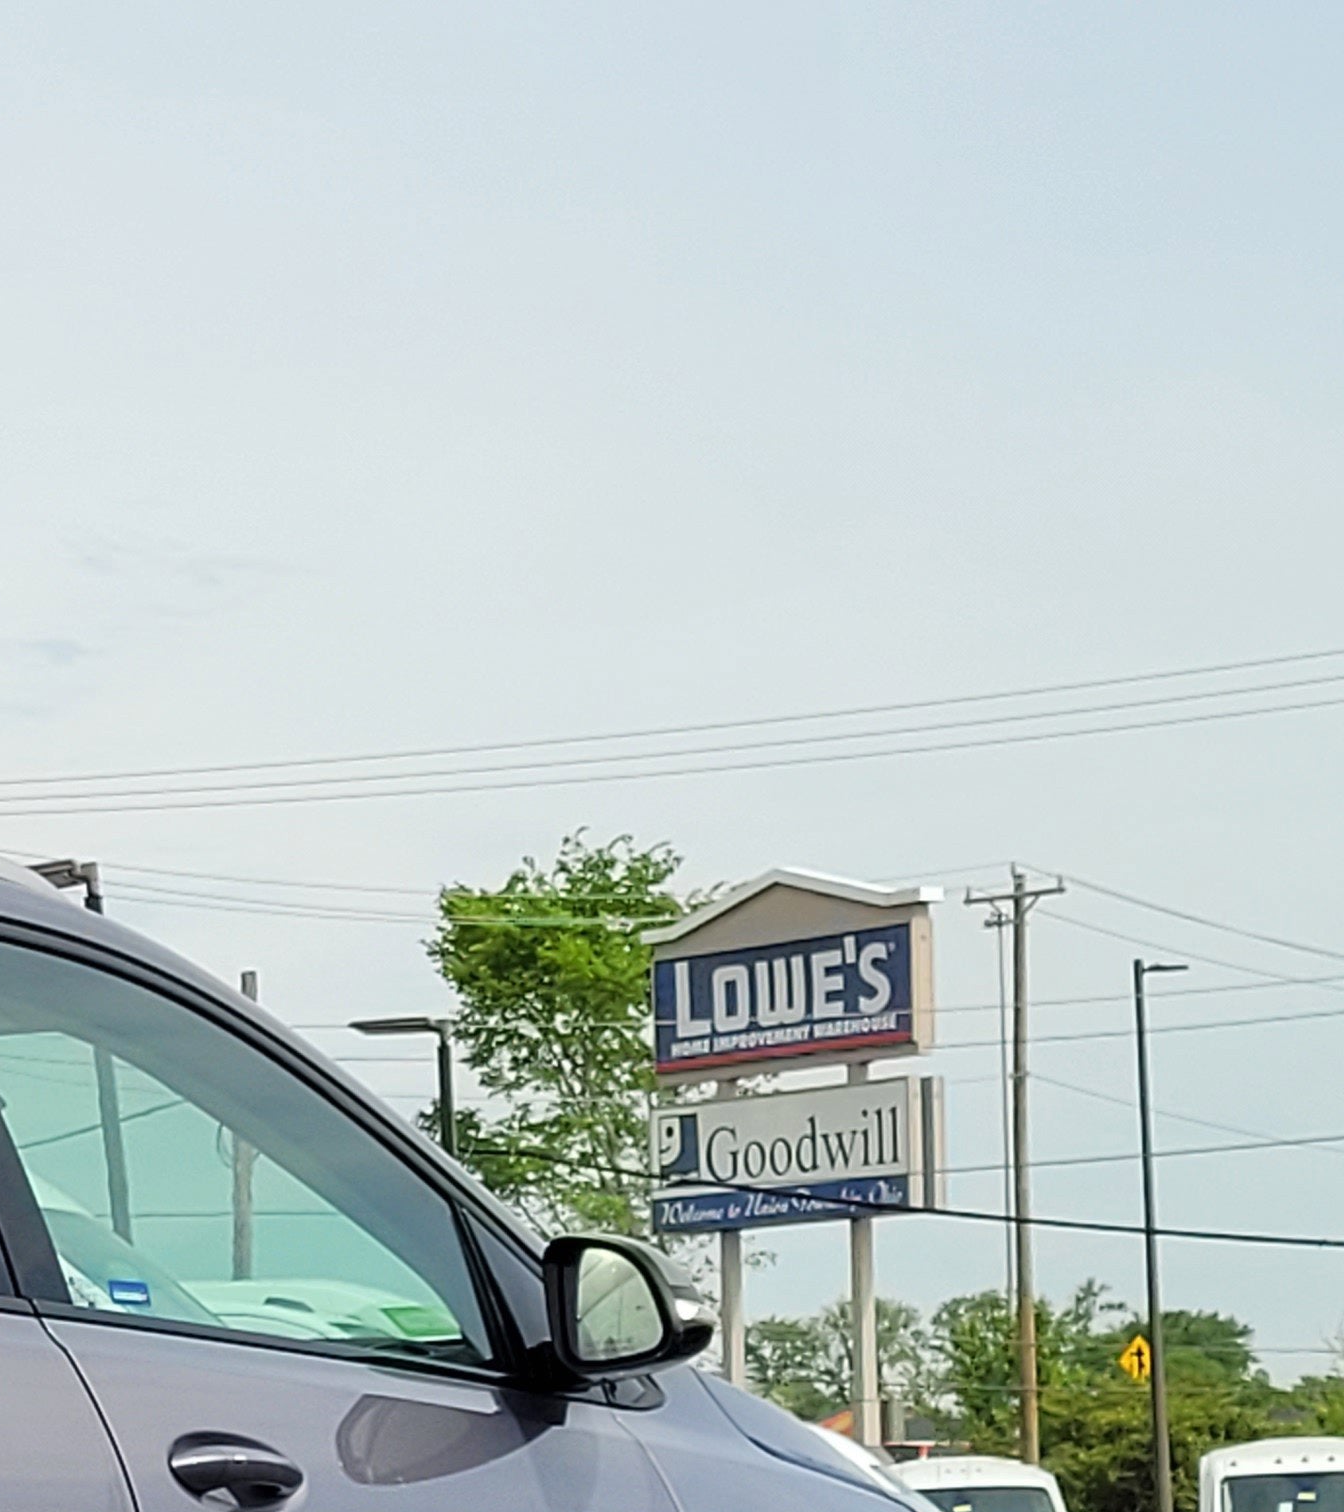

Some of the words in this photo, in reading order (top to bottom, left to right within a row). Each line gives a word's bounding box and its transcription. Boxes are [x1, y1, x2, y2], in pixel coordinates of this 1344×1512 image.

[674, 935, 892, 1039] LOWE'S
[671, 1039, 710, 1058] HOME
[713, 1025, 810, 1053] IMPROVEMENT
[813, 1013, 897, 1040] WAREHOUSE
[706, 1106, 900, 1182] Goodwill
[661, 1202, 724, 1226] Welcome
[727, 1204, 742, 1219] to
